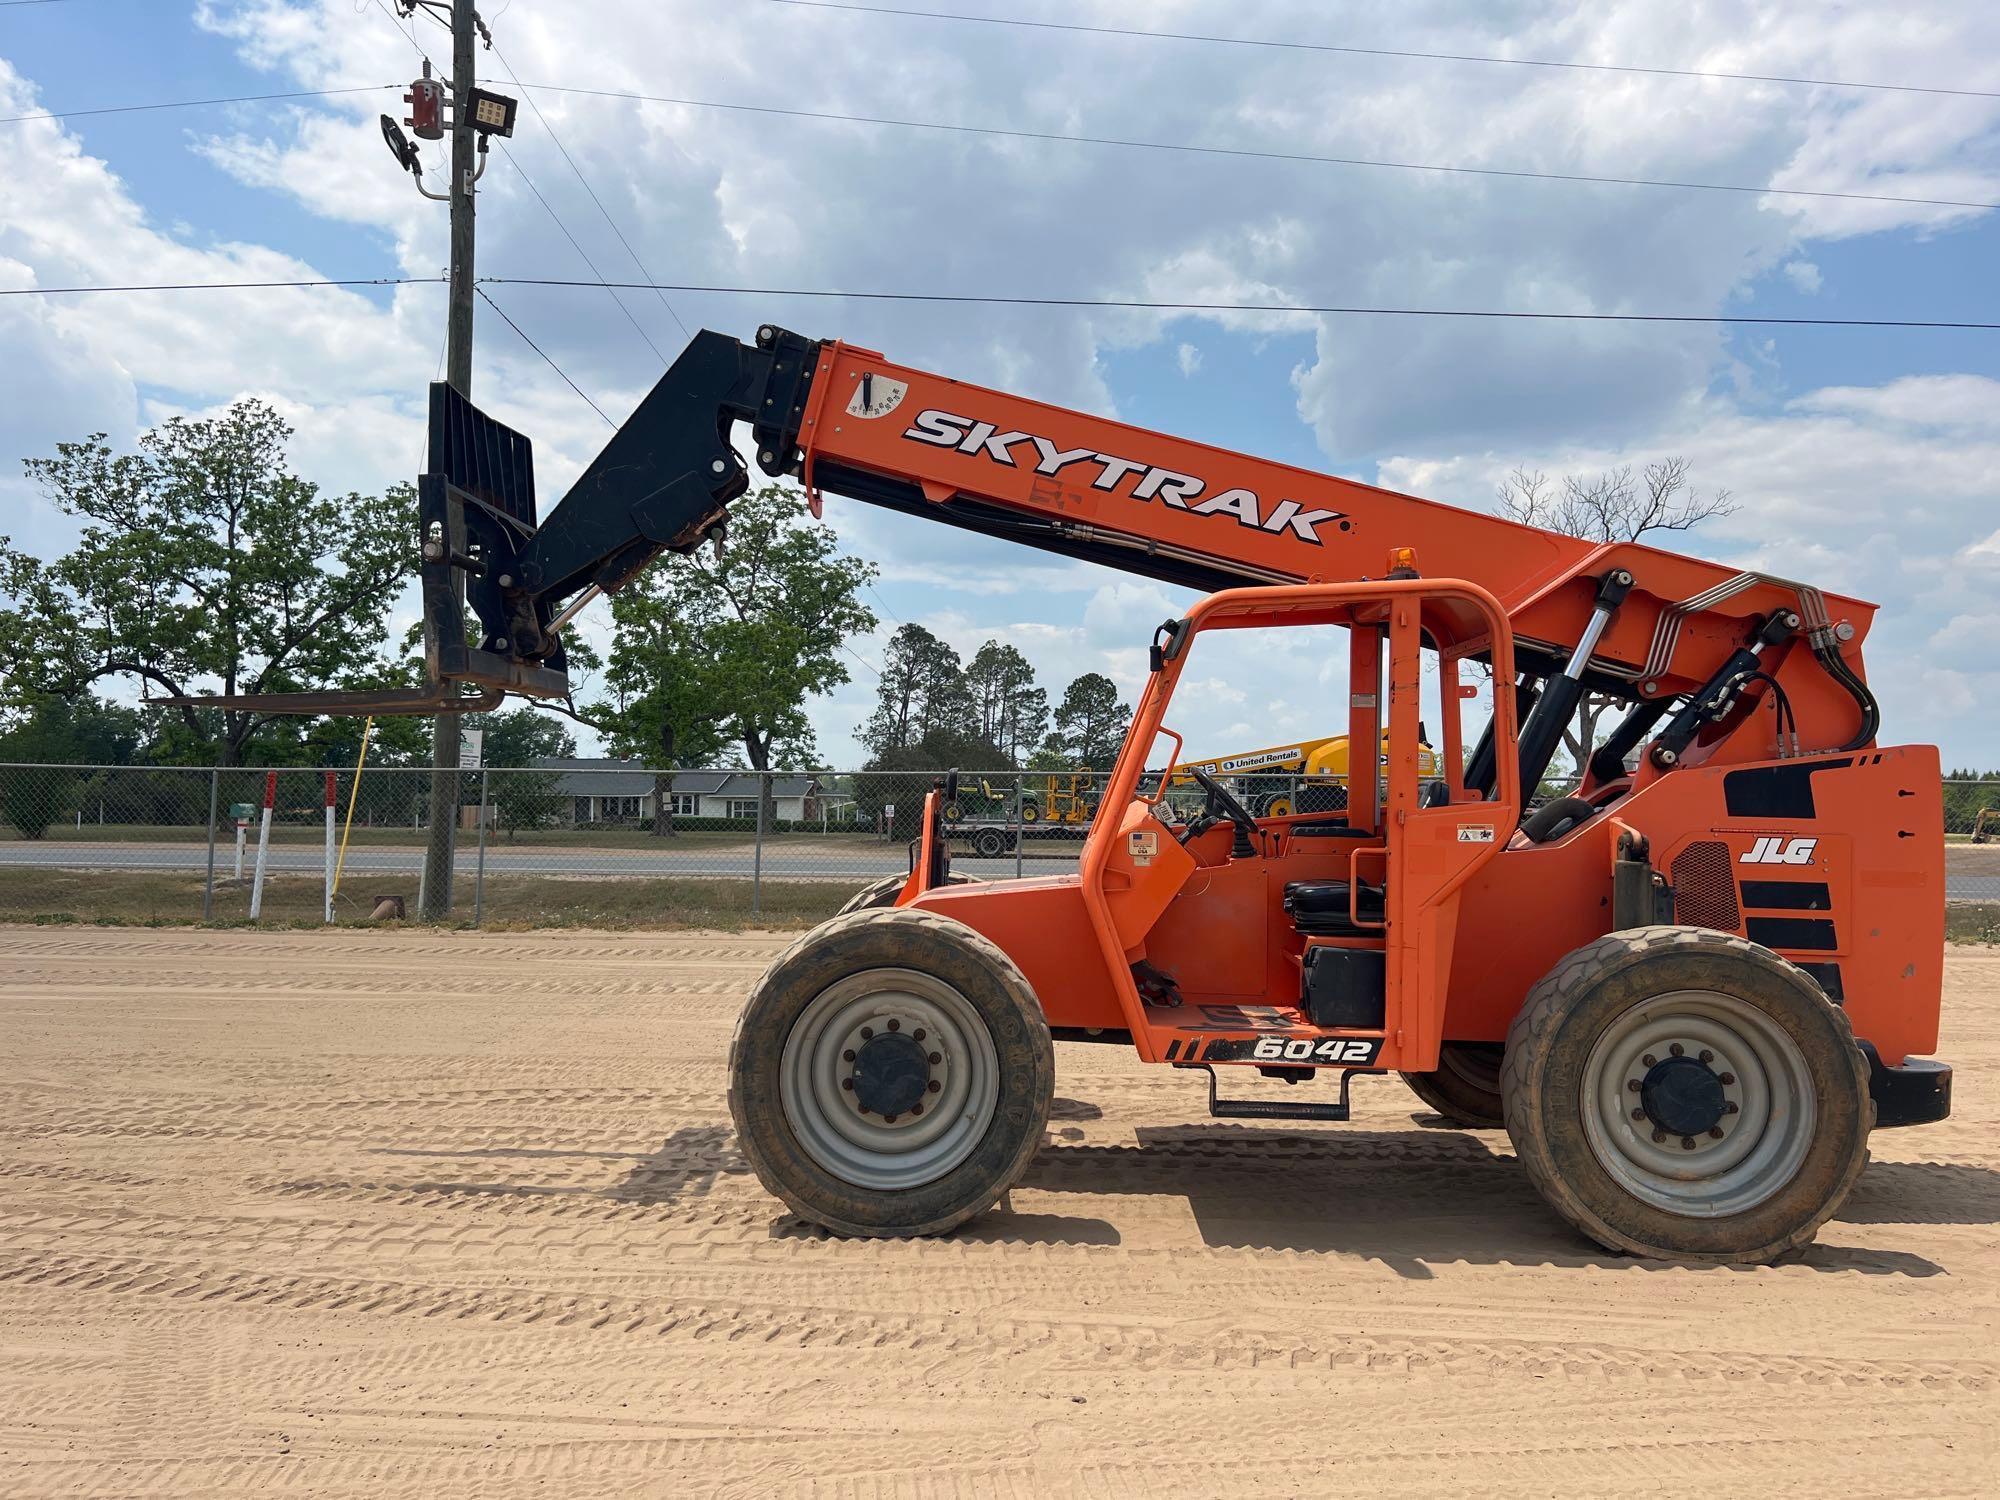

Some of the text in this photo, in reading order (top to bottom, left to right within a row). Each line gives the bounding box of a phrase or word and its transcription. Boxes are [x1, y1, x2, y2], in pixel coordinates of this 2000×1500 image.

[903, 408, 1348, 546] SKYTRAK
[1236, 750, 1298, 768] United Rentals
[1739, 837, 1818, 865] JLG
[1253, 1038, 1373, 1062] 6042
